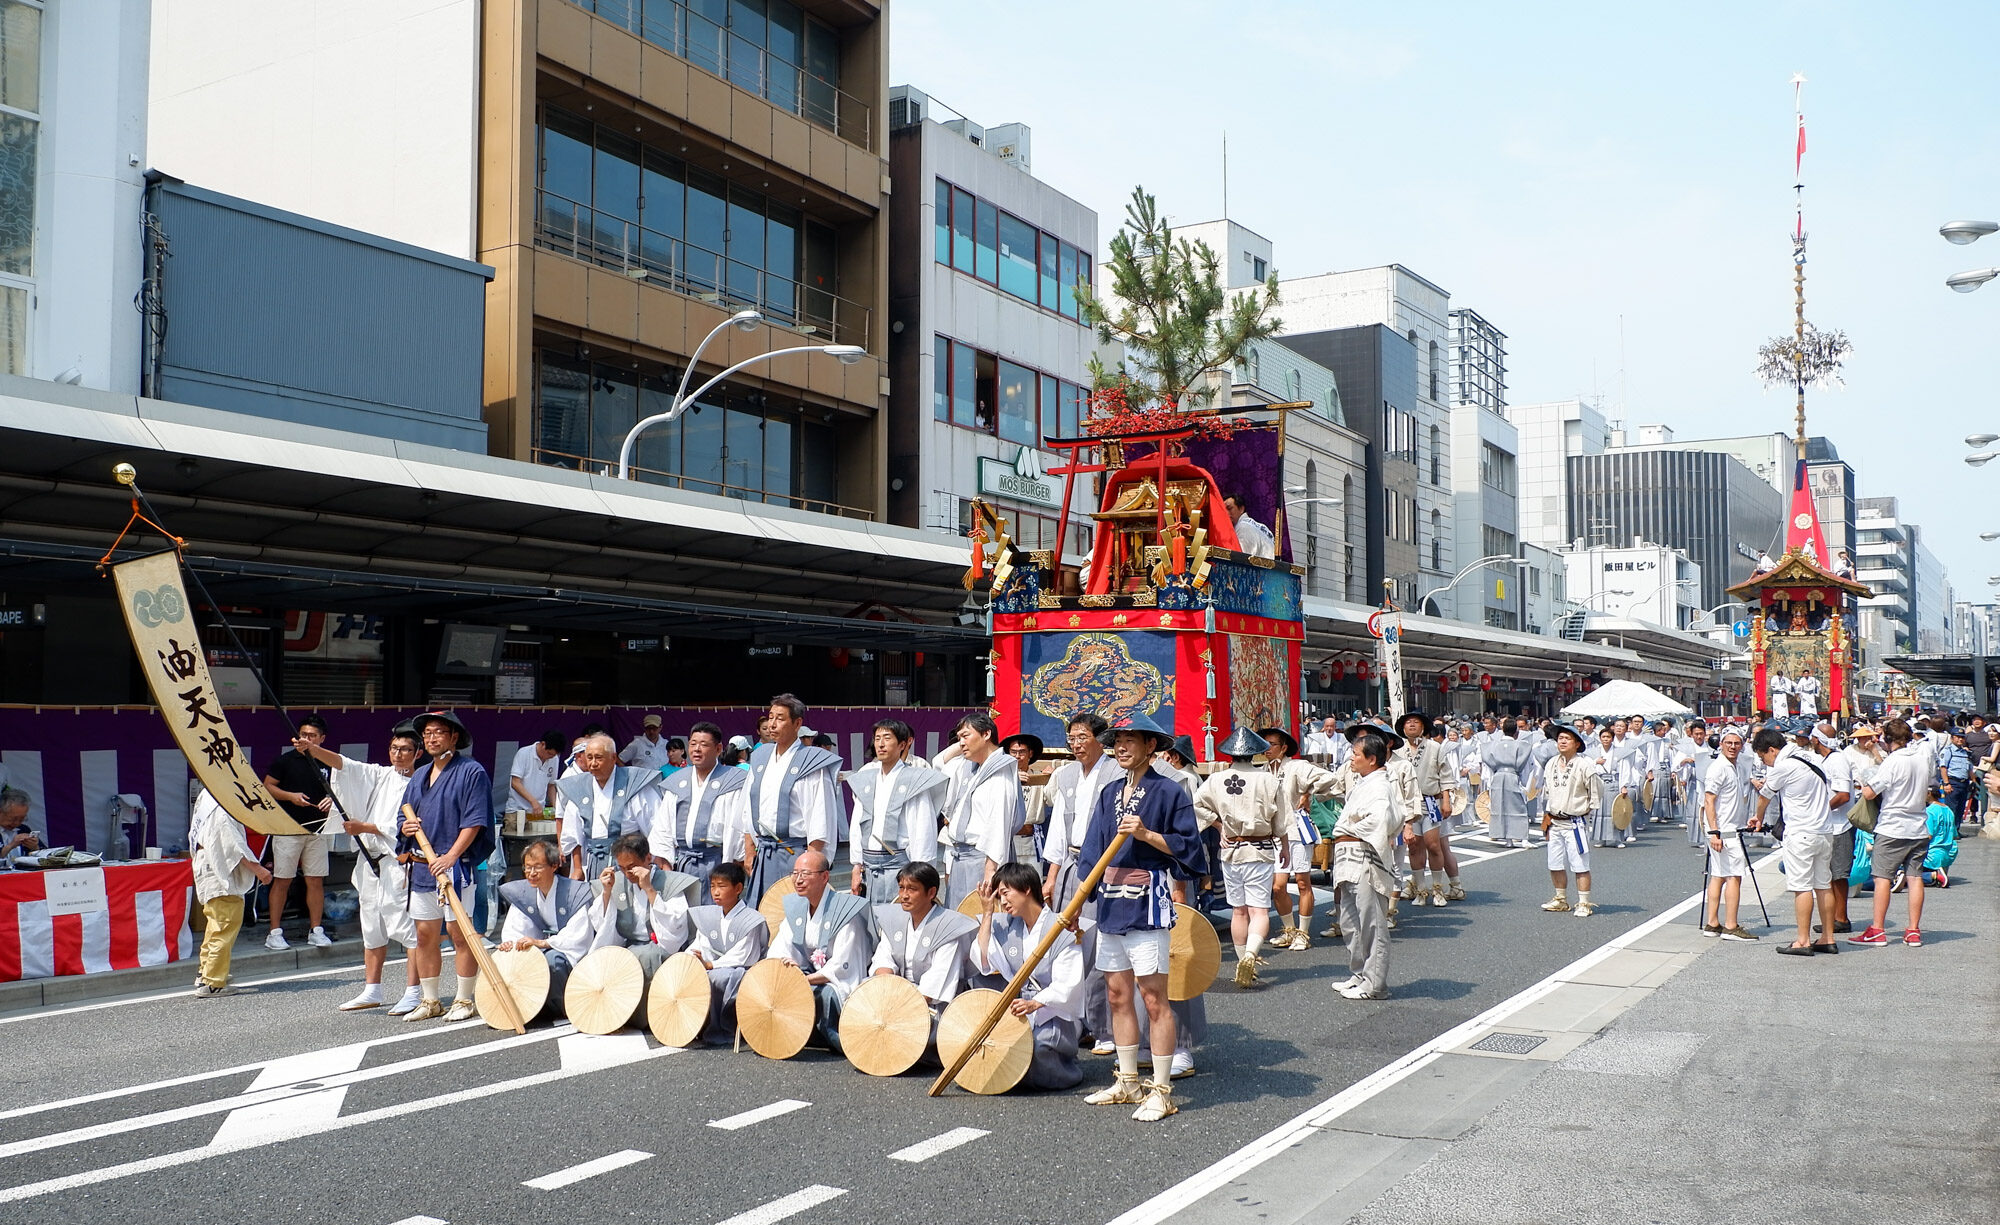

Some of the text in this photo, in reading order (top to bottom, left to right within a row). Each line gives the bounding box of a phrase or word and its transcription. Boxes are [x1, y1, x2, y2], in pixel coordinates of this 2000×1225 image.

[999, 474, 1051, 502] MOS BURGER
[1604, 561, 1656, 572] 飯田屋ビル
[157, 638, 270, 813] 油天神山
